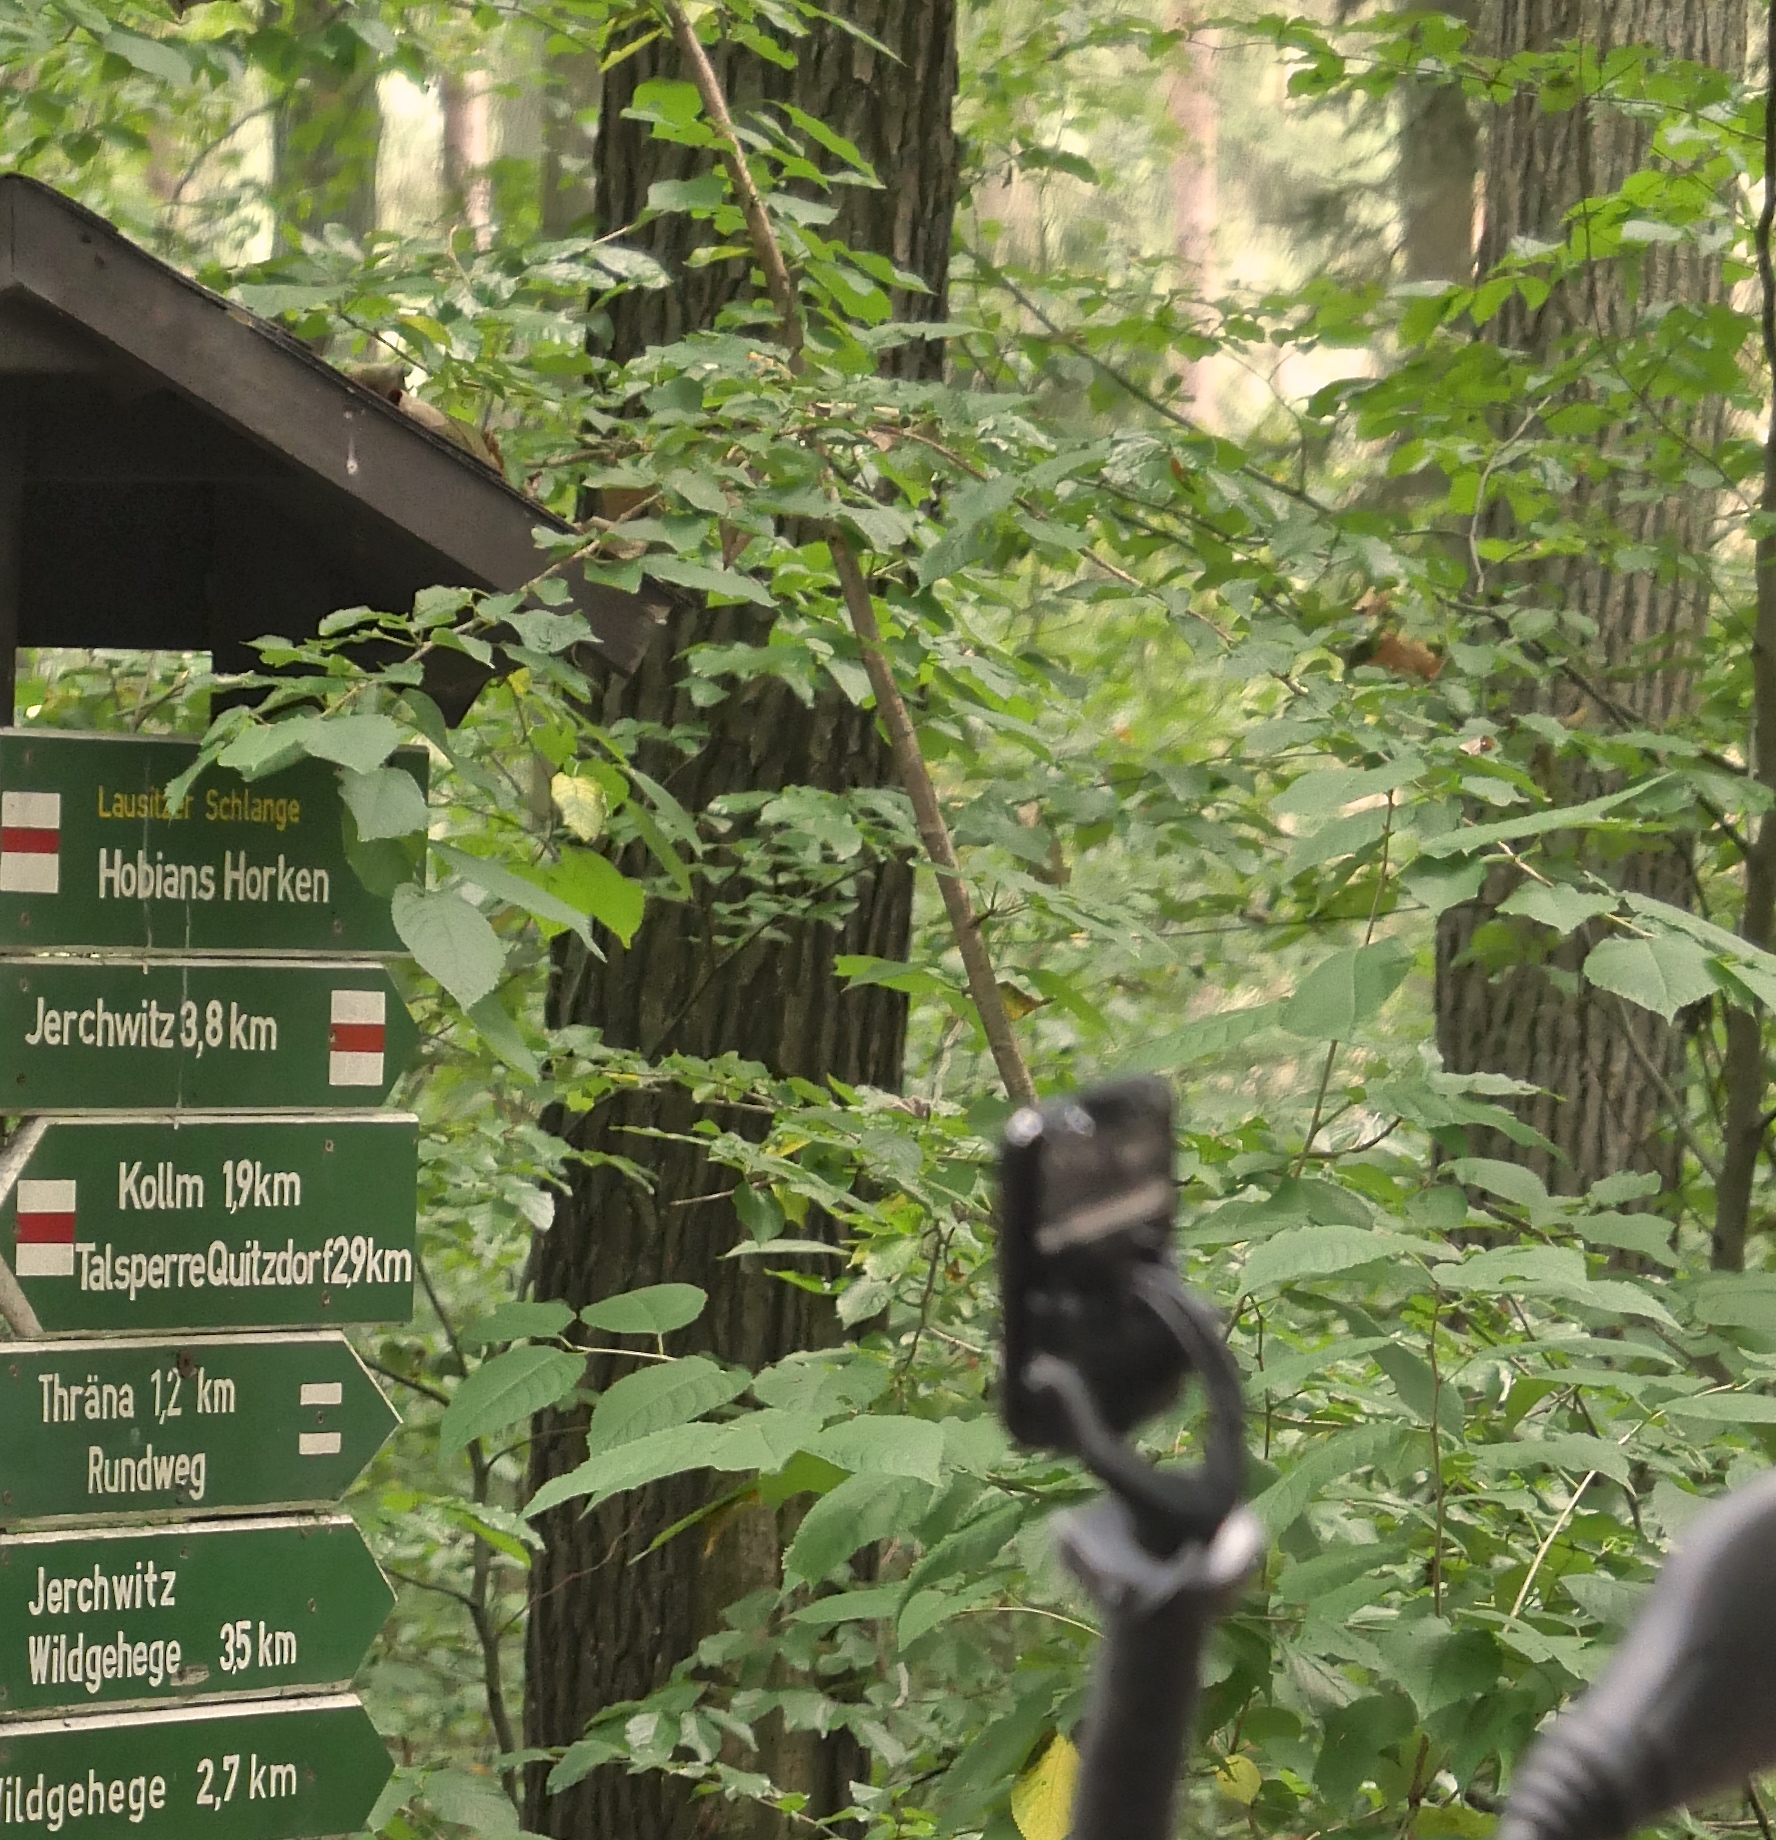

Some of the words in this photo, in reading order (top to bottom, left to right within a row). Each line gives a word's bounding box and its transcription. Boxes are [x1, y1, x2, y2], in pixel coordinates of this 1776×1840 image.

[206, 789, 301, 831] Schlange
[99, 848, 215, 900] Hobians
[225, 851, 329, 902] Horken
[26, 997, 174, 1048] Jerchwitz
[180, 1000, 223, 1059] 3,8
[231, 1002, 277, 1051] km
[119, 1161, 204, 1209] Kollm
[39, 1374, 134, 1423] Thräna
[151, 1367, 182, 1425] 1,2
[197, 1367, 235, 1414] km
[88, 1444, 206, 1501] Rundweg
[28, 1561, 176, 1616] Jerchwitz
[28, 1631, 181, 1693] Wildgehege
[220, 1620, 251, 1675] 3,5
[259, 1621, 297, 1667] km
[196, 1754, 240, 1810] 2,7
[249, 1754, 298, 1799] km
